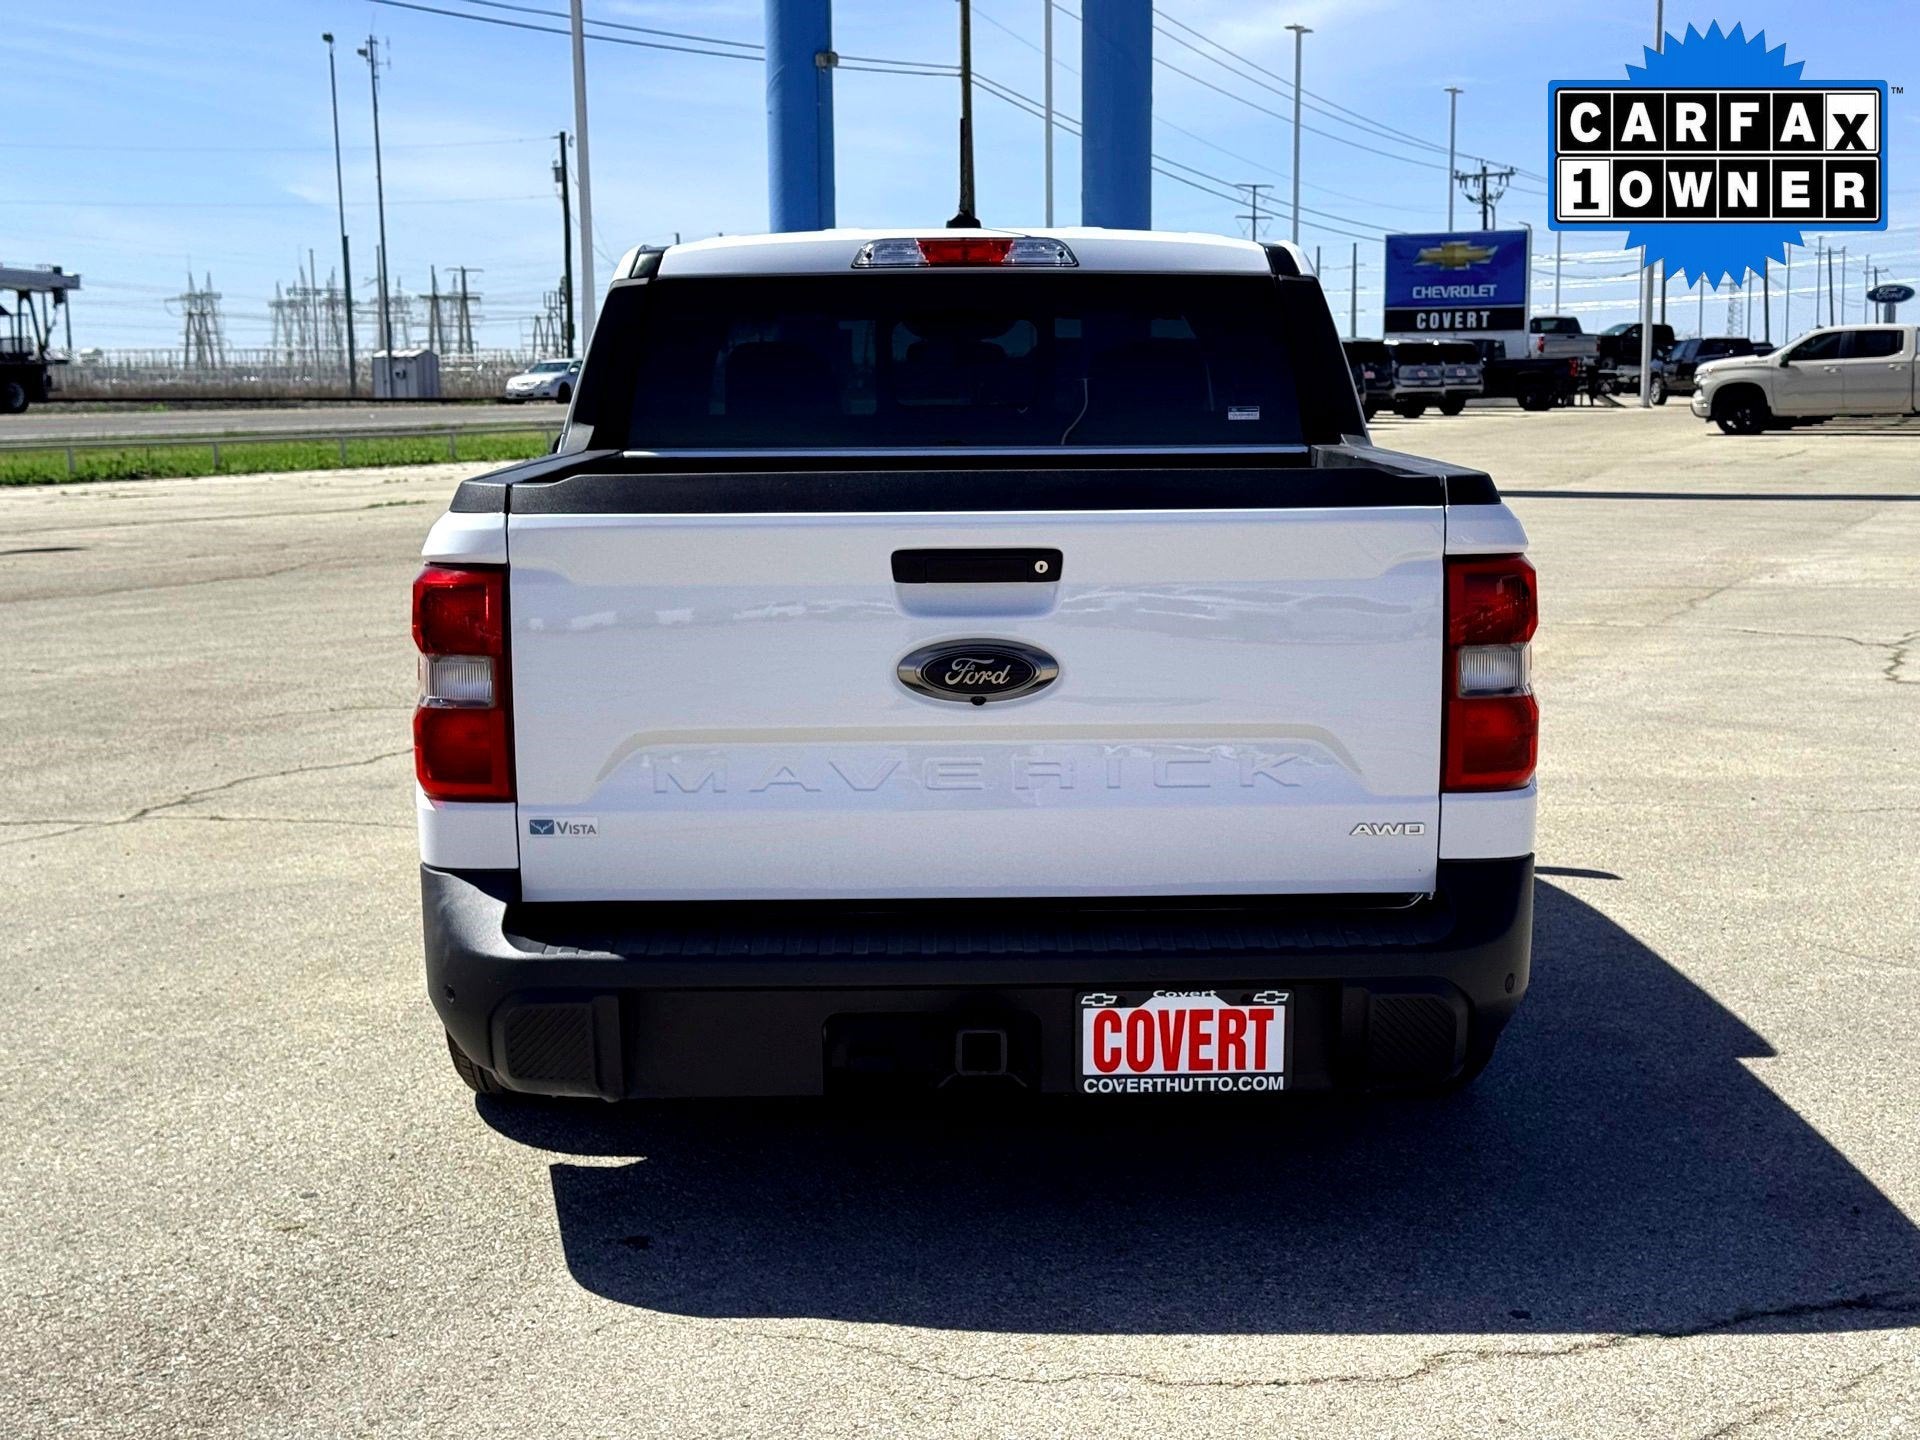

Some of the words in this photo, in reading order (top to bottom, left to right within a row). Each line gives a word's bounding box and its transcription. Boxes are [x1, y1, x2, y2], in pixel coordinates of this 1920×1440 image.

[1412, 284, 1497, 299] CHEVROLET
[1416, 311, 1490, 329] COVERT
[944, 657, 1011, 685] Ford
[653, 754, 1301, 793] MAVERICK
[1349, 822, 1425, 836] AWD
[1152, 989, 1217, 998] Covert
[1093, 1008, 1275, 1073] COVERT
[1083, 1076, 1284, 1094] COVERTHUTTO.COM
